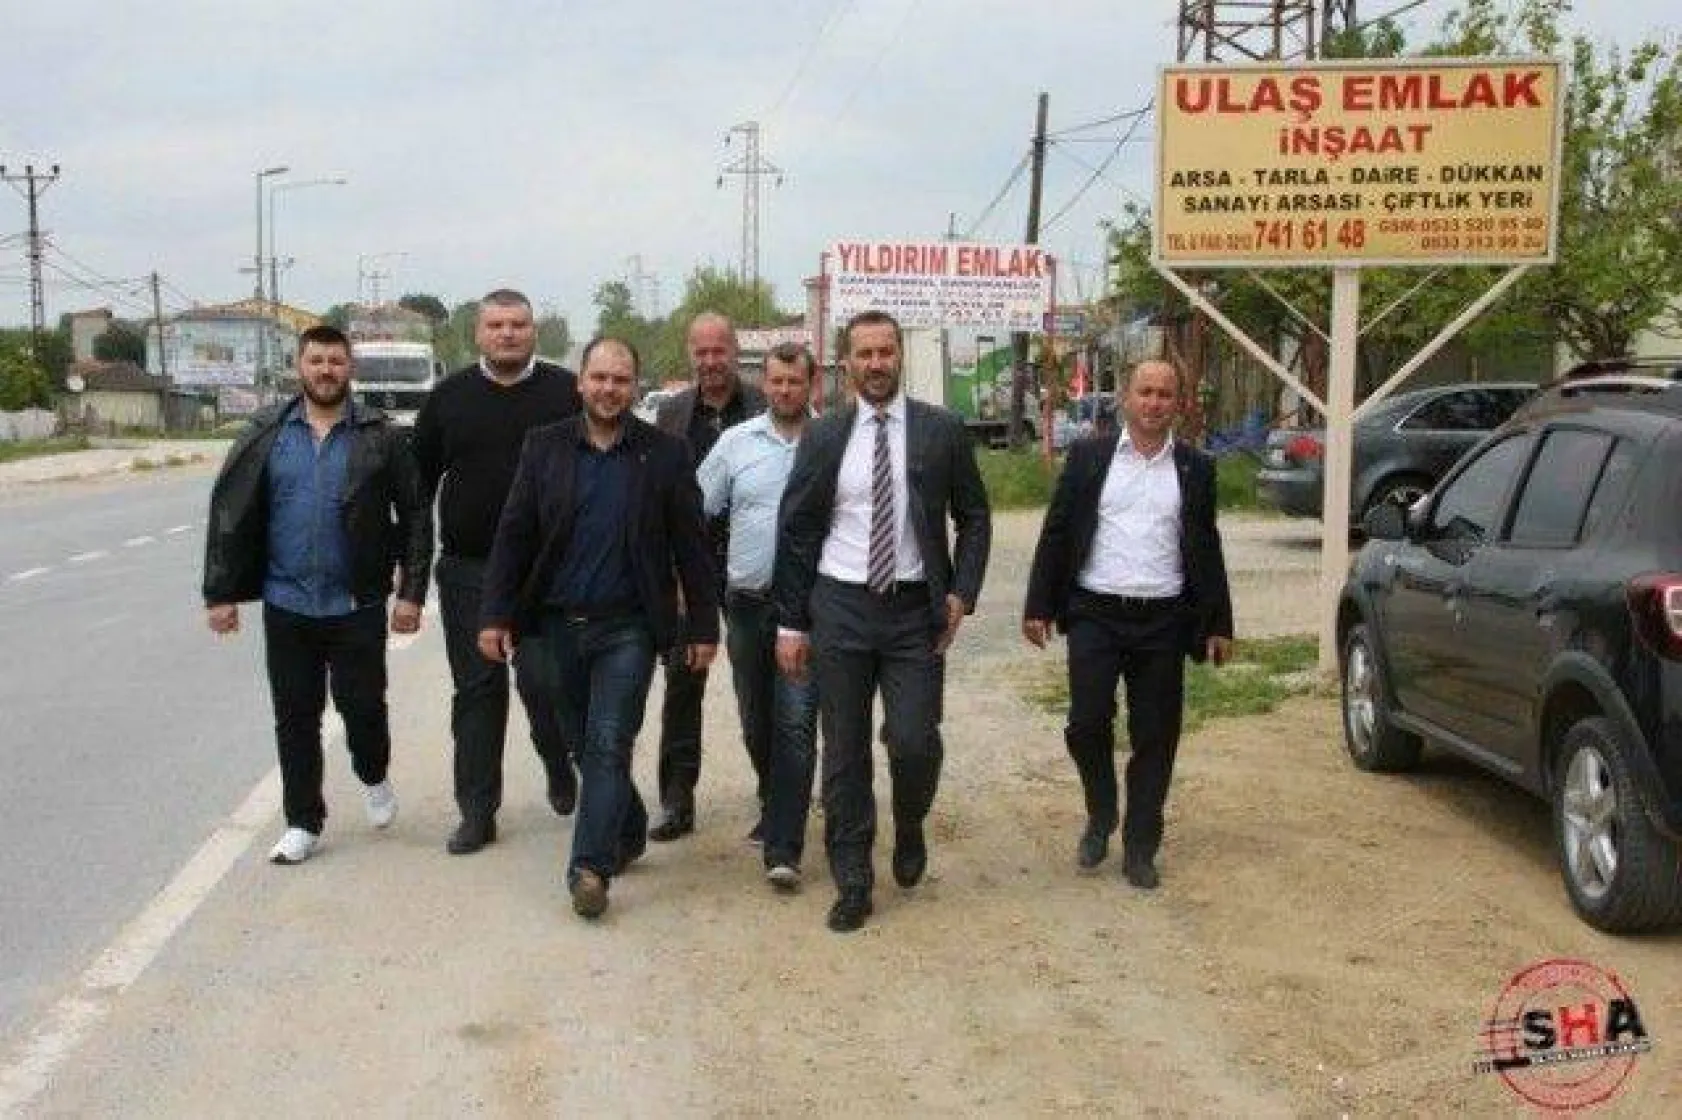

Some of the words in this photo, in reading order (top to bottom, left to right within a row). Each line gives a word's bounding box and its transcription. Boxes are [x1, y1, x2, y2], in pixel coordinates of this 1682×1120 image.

[1176, 77, 1322, 122] ULAŞ
[1342, 71, 1542, 111] EMLAK
[1171, 170, 1232, 187] ARSA
[1254, 168, 1328, 185] TARLA
[1440, 163, 1543, 183] DÜKKAN
[1276, 194, 1361, 210] ARSASI
[1255, 220, 1293, 249] 741
[1303, 219, 1327, 249] 61
[1337, 219, 1365, 248] 48
[838, 244, 947, 273] YILDIRIM
[957, 246, 1042, 277] EMLAK
